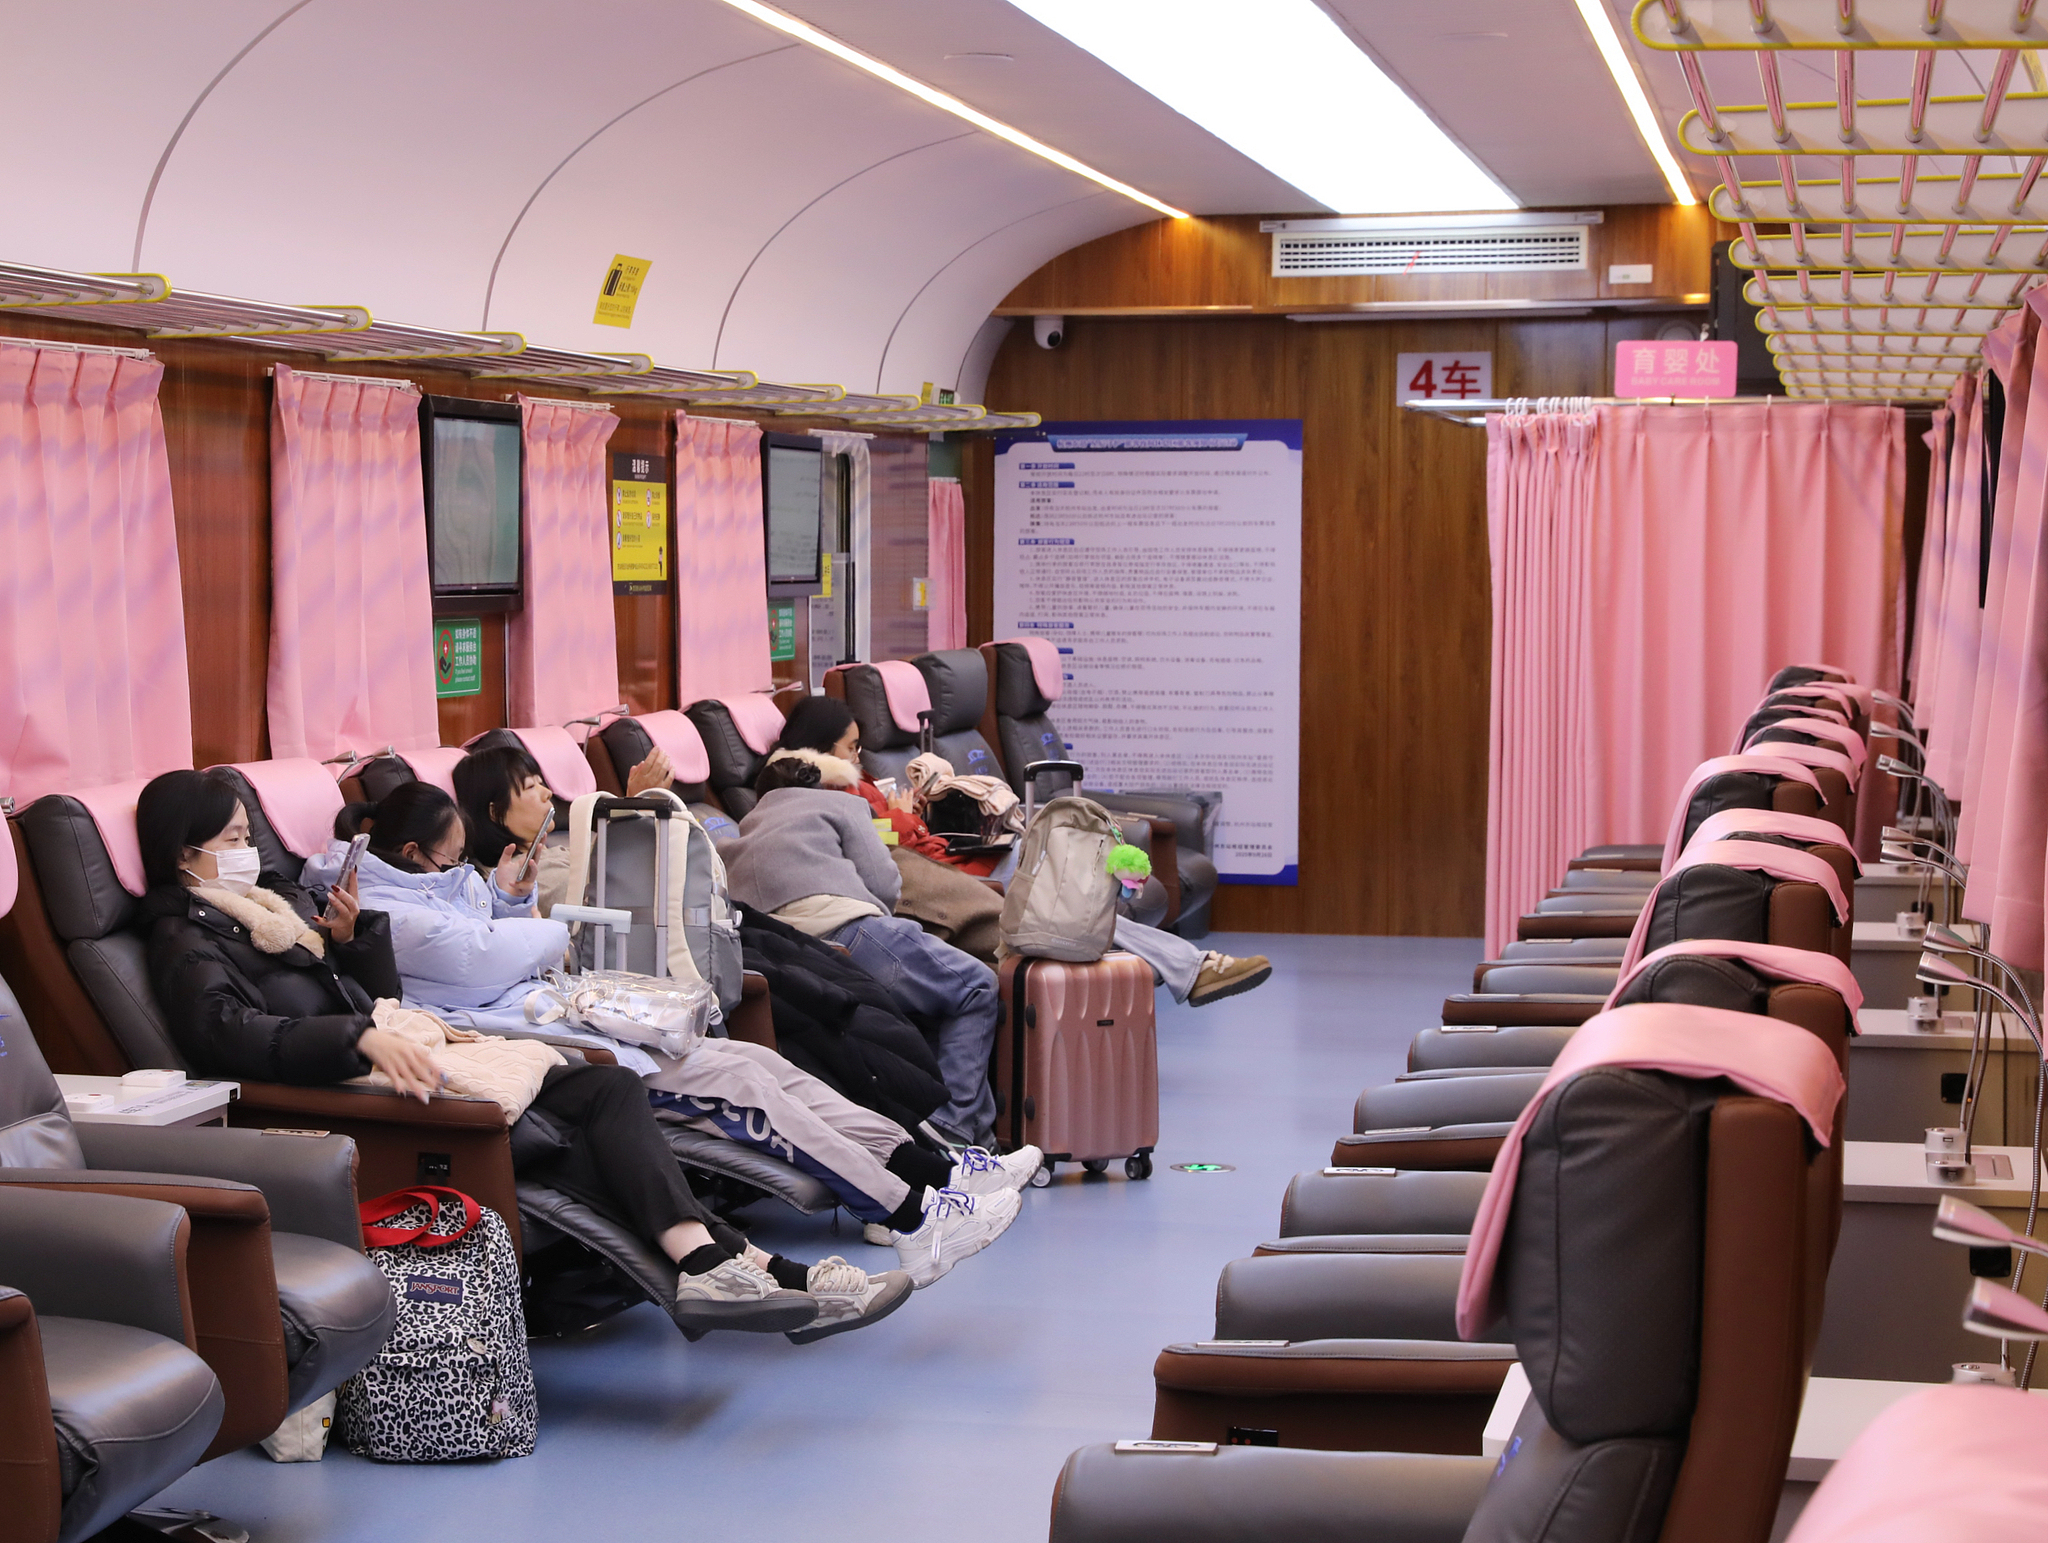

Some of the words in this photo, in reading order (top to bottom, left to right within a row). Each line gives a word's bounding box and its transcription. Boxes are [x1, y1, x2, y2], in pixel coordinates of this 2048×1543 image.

[1632, 347, 1720, 375] 育婴处
[1409, 359, 1481, 399] 4车
[1631, 376, 1659, 386] BABY
[1661, 376, 1688, 386] CARE
[1690, 376, 1721, 386] ROOM
